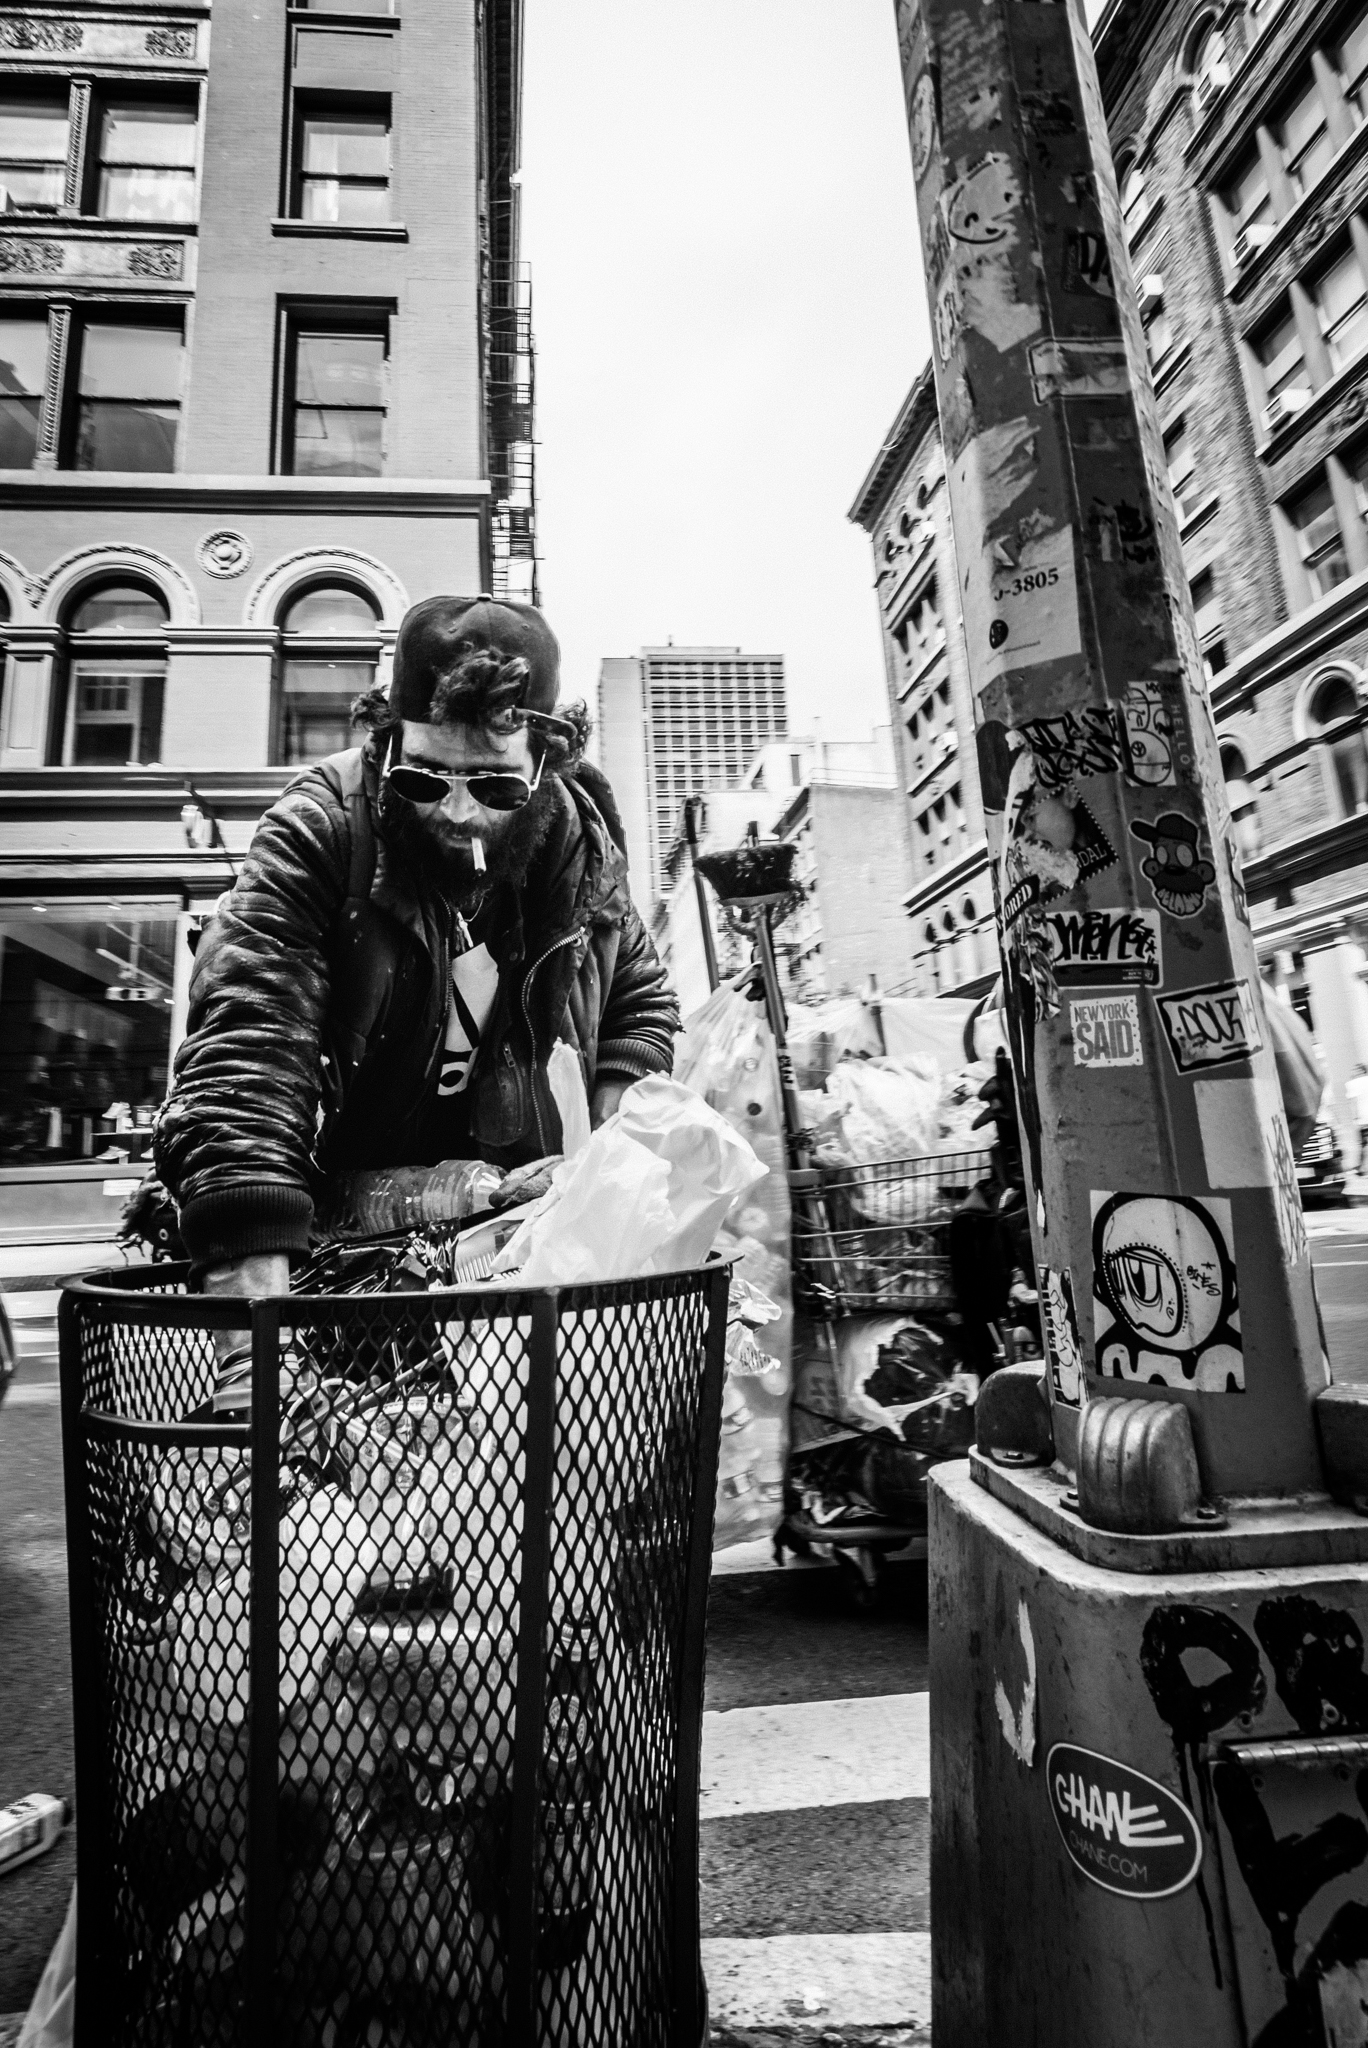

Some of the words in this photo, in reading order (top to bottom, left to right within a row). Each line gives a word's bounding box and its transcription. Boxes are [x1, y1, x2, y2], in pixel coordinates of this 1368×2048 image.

[1171, 704, 1191, 765] HELLO
[1074, 1004, 1099, 1023] NEW
[1100, 1003, 1131, 1020] YORK
[1076, 1019, 1135, 1061] SAID
[1055, 1772, 1185, 1848] CHANE
